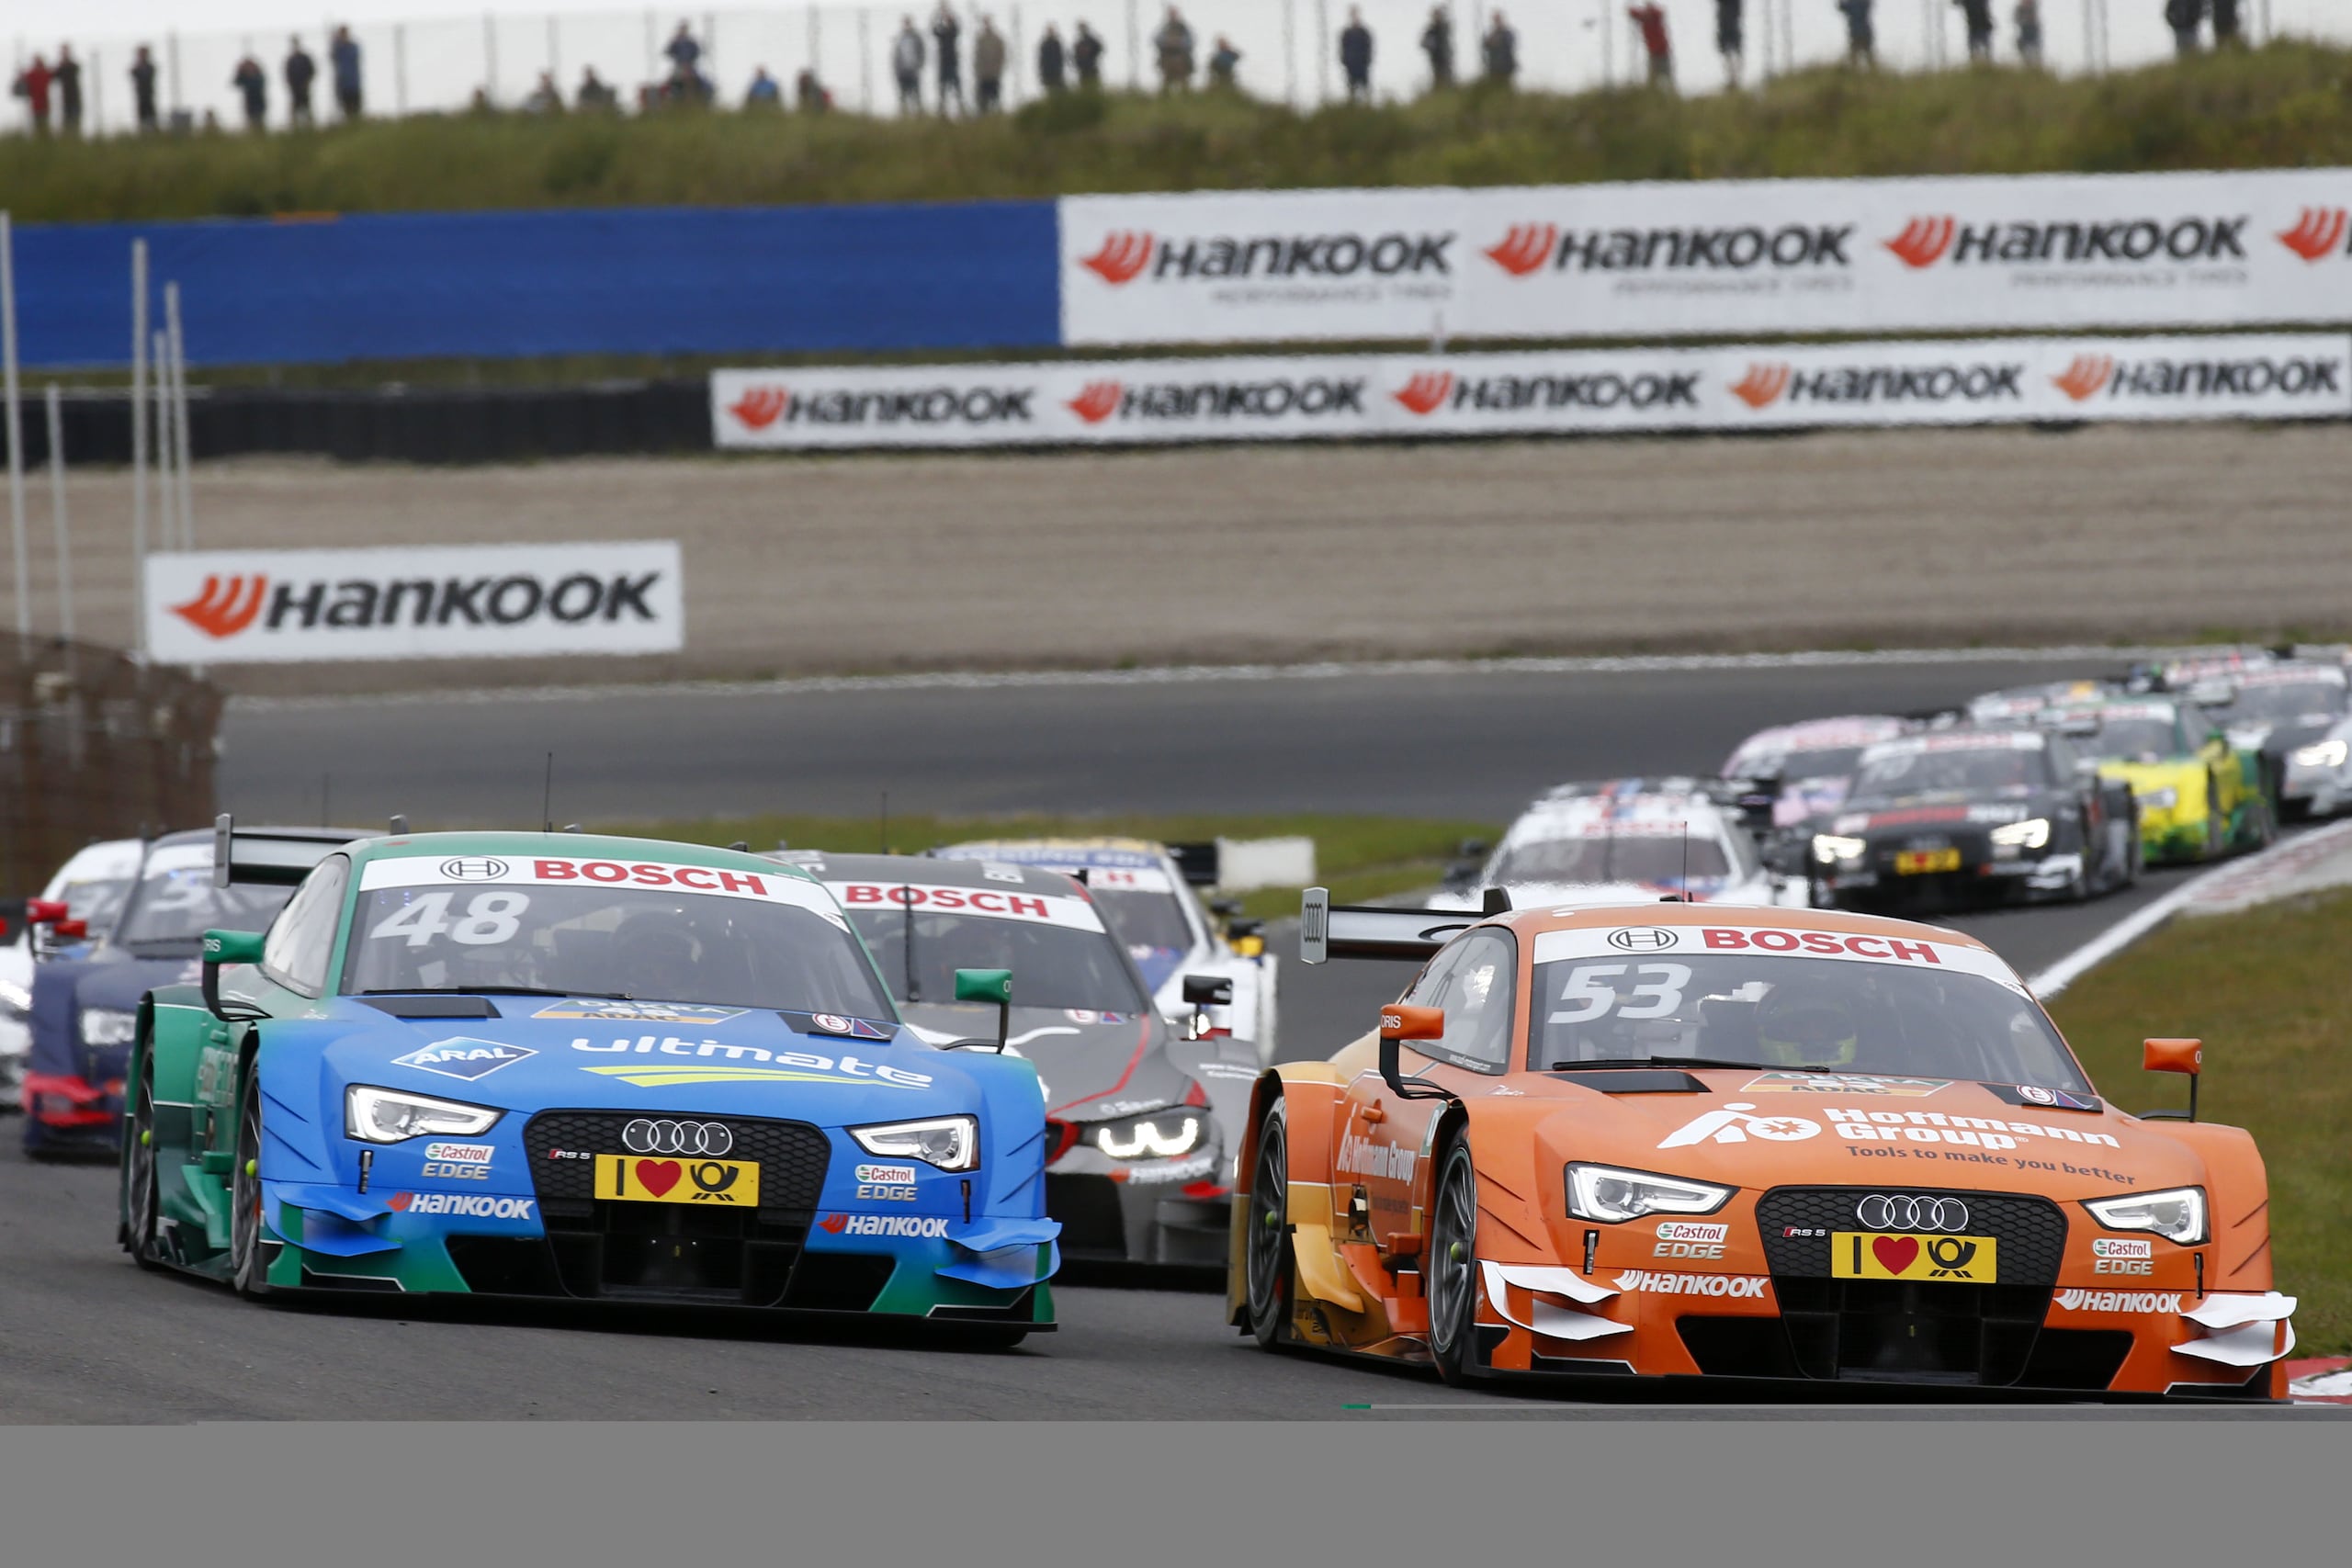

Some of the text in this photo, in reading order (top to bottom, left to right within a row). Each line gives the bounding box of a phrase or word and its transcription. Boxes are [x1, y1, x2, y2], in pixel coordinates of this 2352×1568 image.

[534, 860, 768, 896] BOSCH
[846, 885, 1049, 918] BOSCH
[369, 889, 531, 947] 48
[1702, 929, 1941, 964] BOSCH
[1547, 963, 1692, 1024] 53
[414, 1047, 518, 1065] ARAL
[570, 1035, 933, 1089] ultimate
[1823, 1108, 2120, 1148] Hoffmann
[441, 1145, 489, 1161] Castrol
[422, 1163, 492, 1180] EDGE
[1846, 1145, 2135, 1186] Tools to make you better
[871, 1168, 912, 1182] Castrol
[856, 1185, 918, 1201] EDGE
[1673, 1224, 1723, 1240] Castrol
[1653, 1242, 1727, 1259] EDGE
[2108, 1241, 2148, 1256] Castrol
[2095, 1259, 2154, 1276] EDGE
